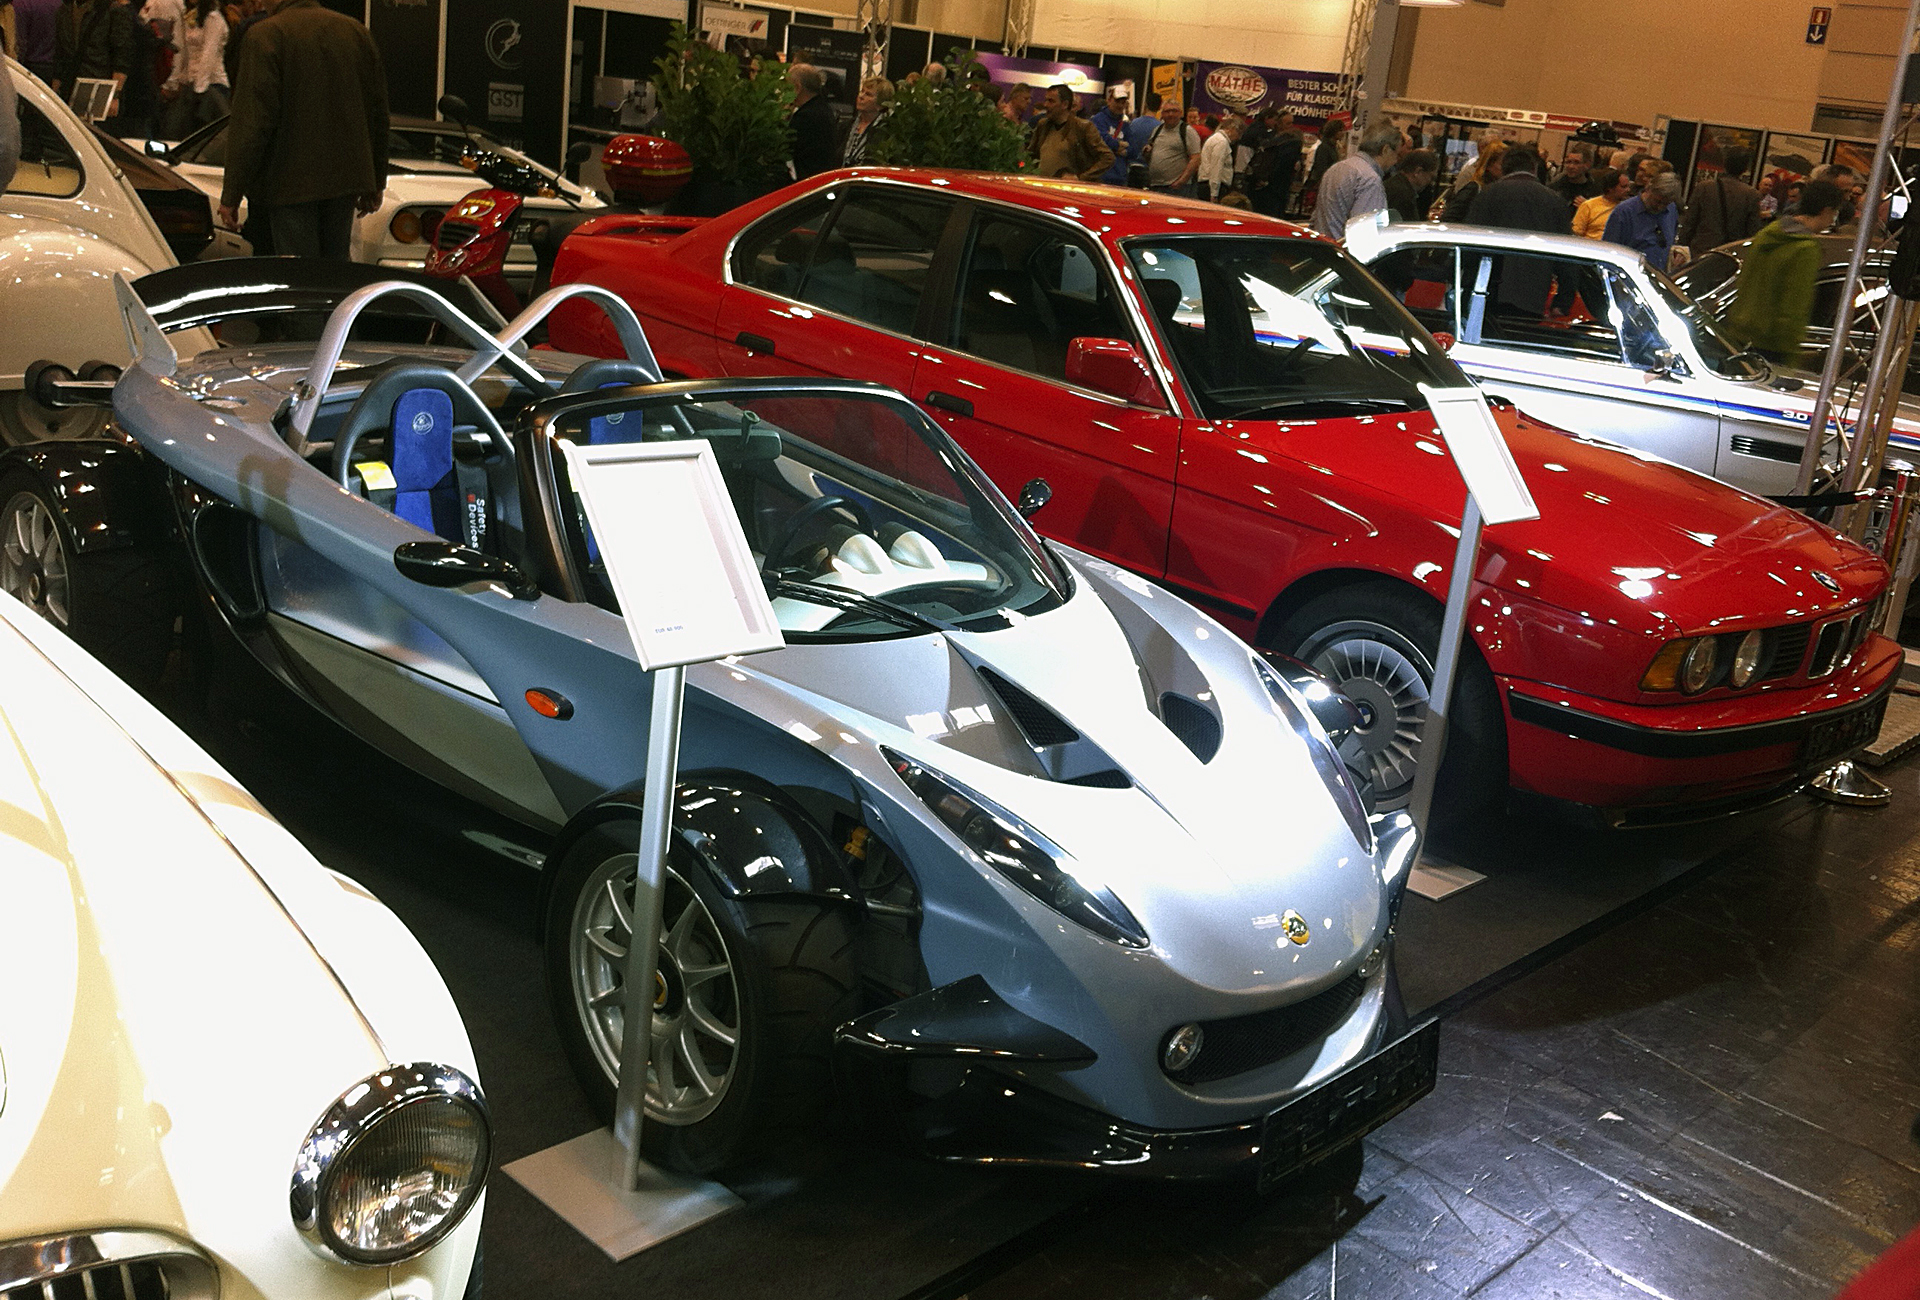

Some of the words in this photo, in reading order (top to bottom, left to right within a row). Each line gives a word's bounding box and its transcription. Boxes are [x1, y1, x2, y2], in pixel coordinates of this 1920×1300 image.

[1288, 79, 1320, 91] BESTER
[490, 88, 520, 108] GST
[1286, 90, 1303, 102] FÜR
[1782, 409, 1809, 421] 3.0
[476, 498, 487, 535] Safety
[468, 503, 479, 549] Devices
